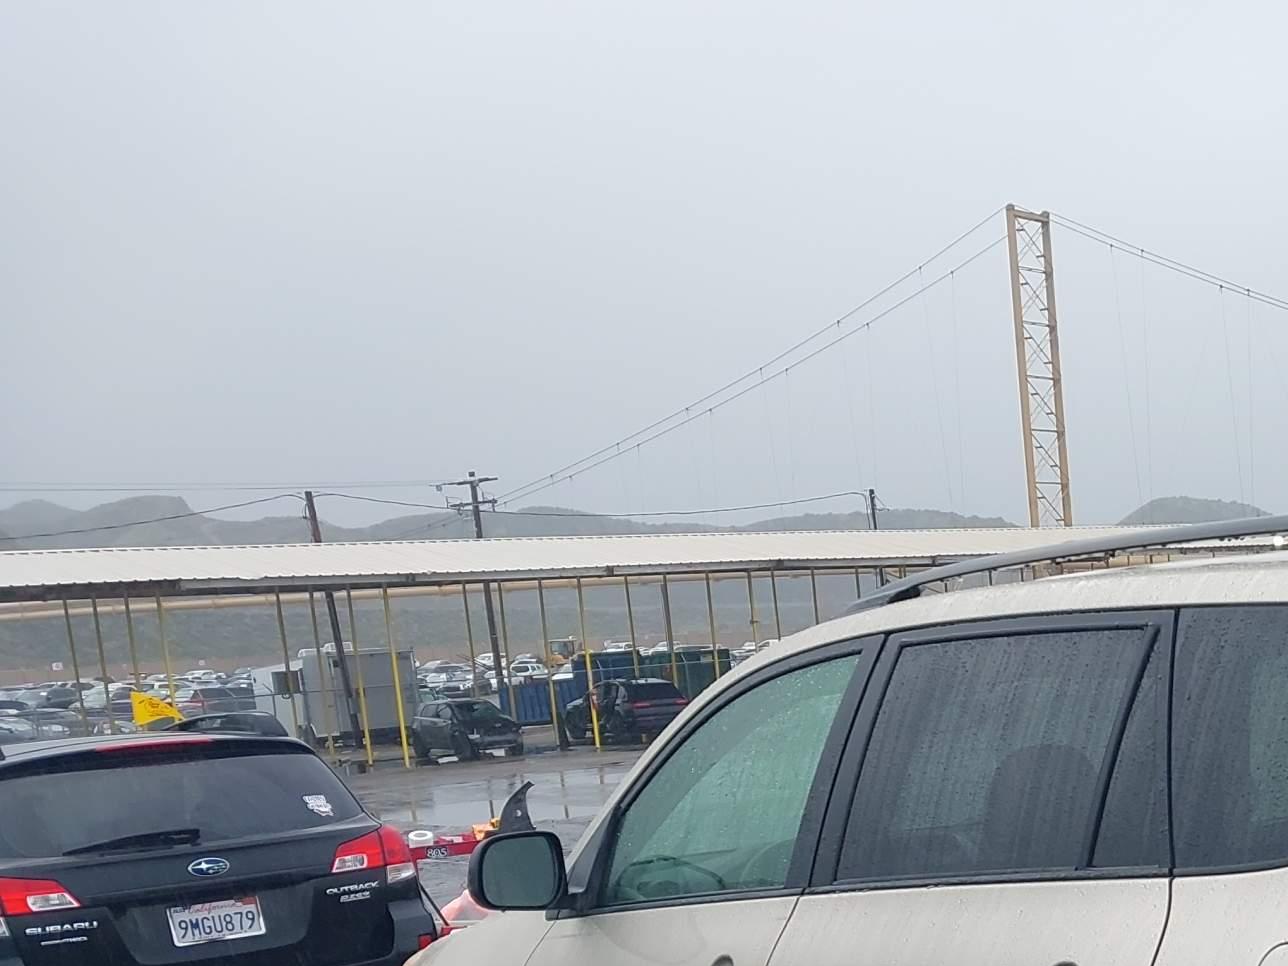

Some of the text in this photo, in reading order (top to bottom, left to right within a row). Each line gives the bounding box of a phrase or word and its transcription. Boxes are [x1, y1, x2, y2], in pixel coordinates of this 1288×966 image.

[427, 846, 448, 858] 805
[326, 881, 379, 895] OUTBACK
[25, 920, 98, 936] SUBARU
[178, 910, 256, 939] 9MGU879
